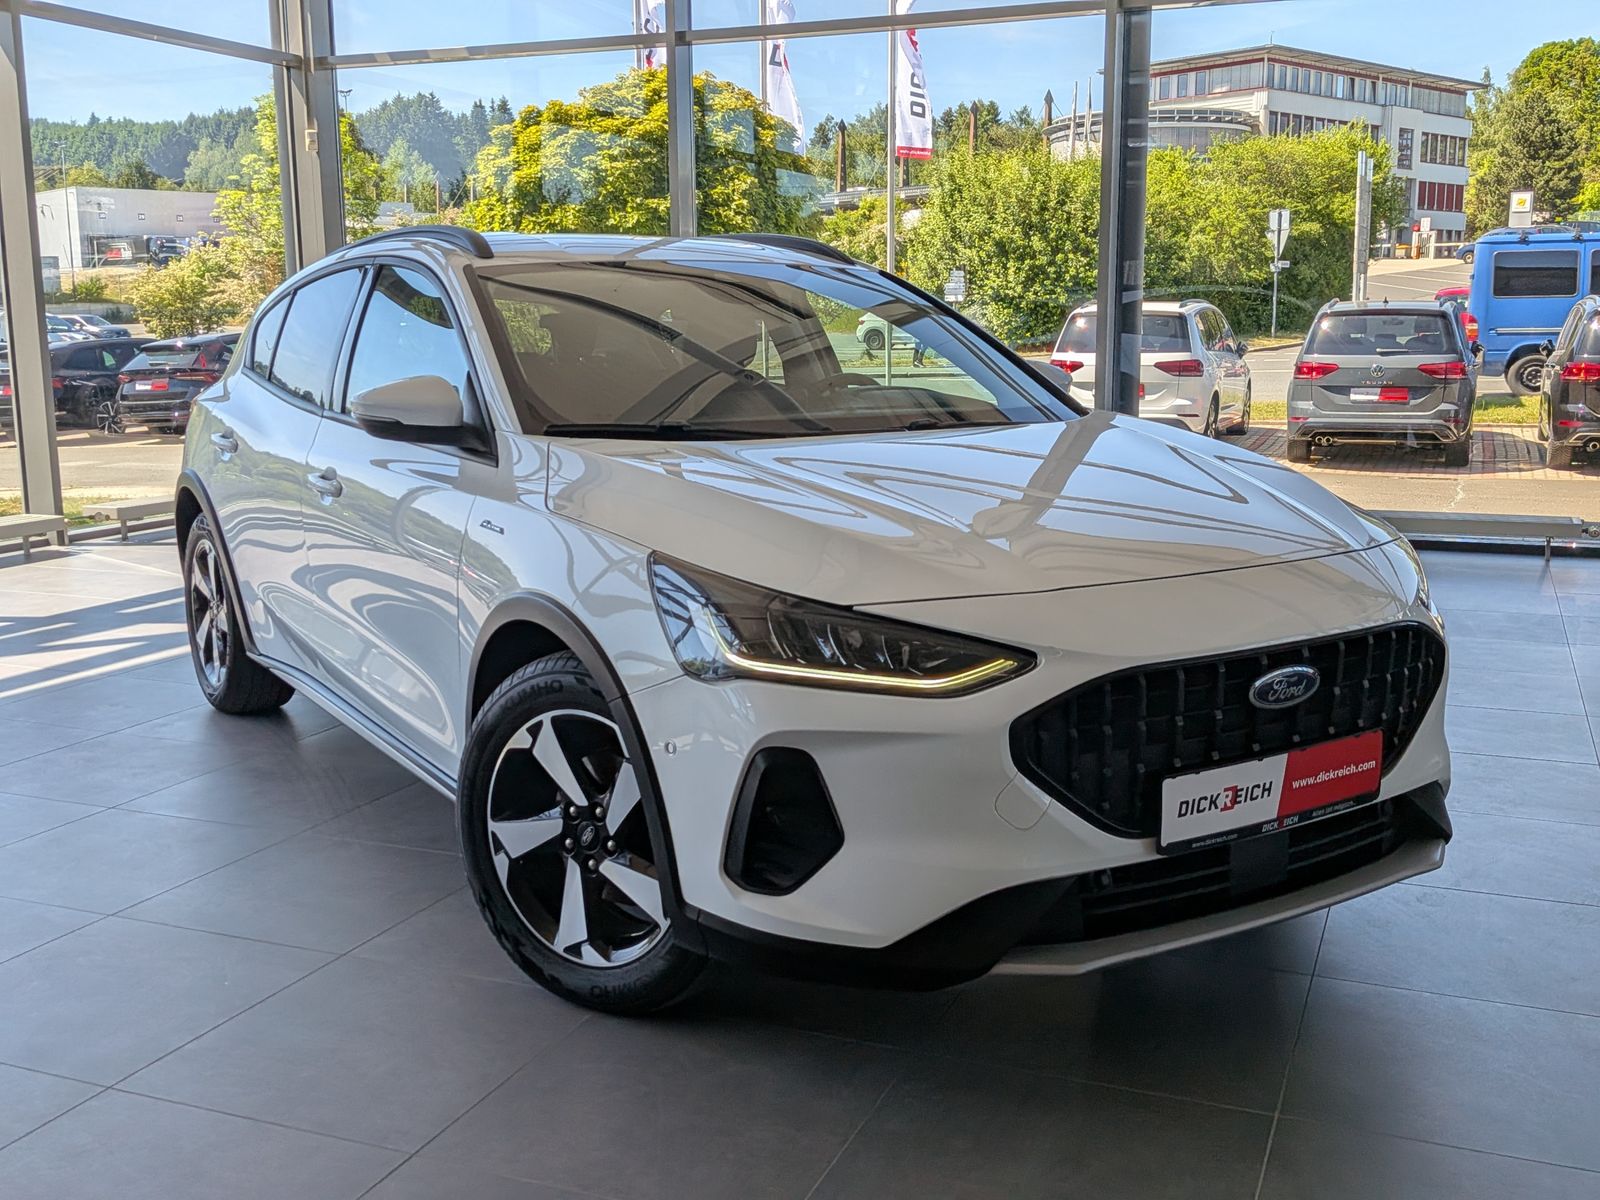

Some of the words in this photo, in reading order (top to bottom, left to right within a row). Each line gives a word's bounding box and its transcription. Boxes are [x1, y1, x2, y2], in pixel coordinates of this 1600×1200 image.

[1268, 676, 1305, 700] Ford
[1292, 758, 1376, 790] www.dickreich.com
[1177, 780, 1273, 818] DICKREICH
